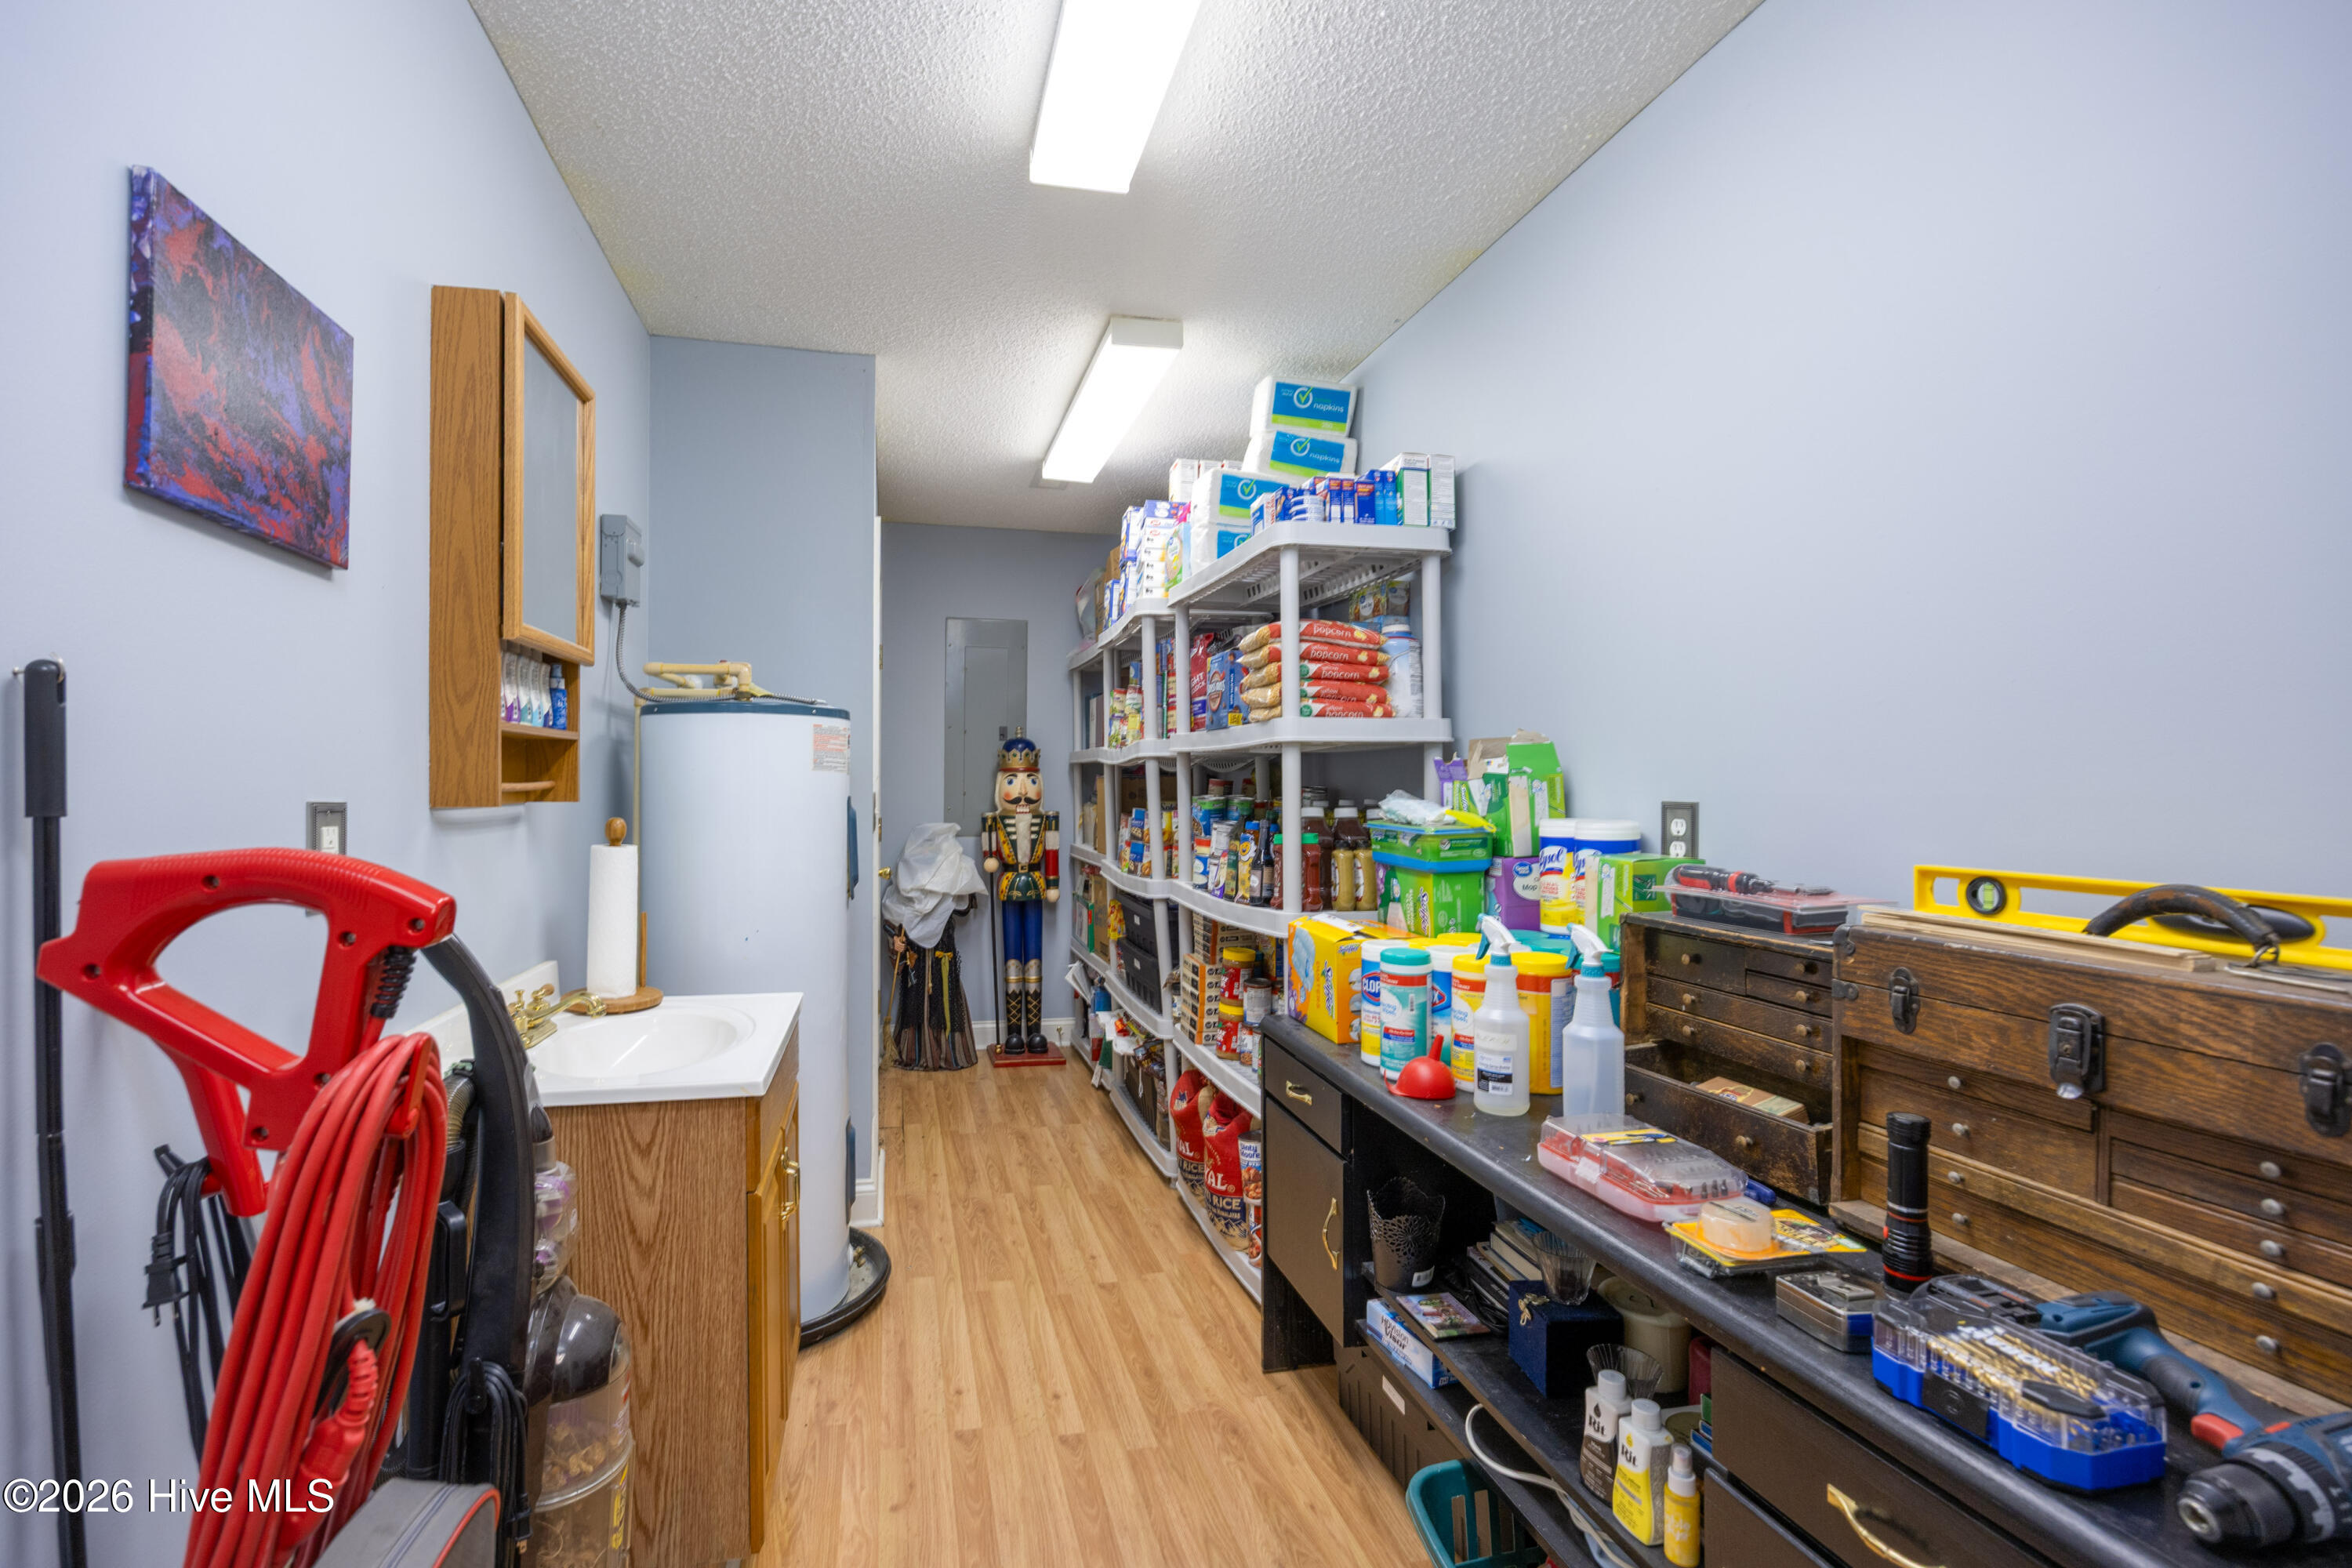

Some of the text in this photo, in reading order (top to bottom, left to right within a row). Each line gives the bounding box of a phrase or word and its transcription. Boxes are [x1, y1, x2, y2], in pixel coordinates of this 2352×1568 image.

[1313, 402, 1345, 413] napkins
[1309, 452, 1341, 464] napkins
[1313, 623, 1352, 637] popcorn
[1310, 649, 1349, 662] popcorn
[1321, 670, 1360, 681] popcorn
[1362, 978, 1380, 993] CLOR
[1213, 1195, 1242, 1211] RICE
[1385, 1326, 1406, 1350] Visor
[1588, 1415, 1606, 1436] Rit
[1621, 1443, 1638, 1467] Rit
